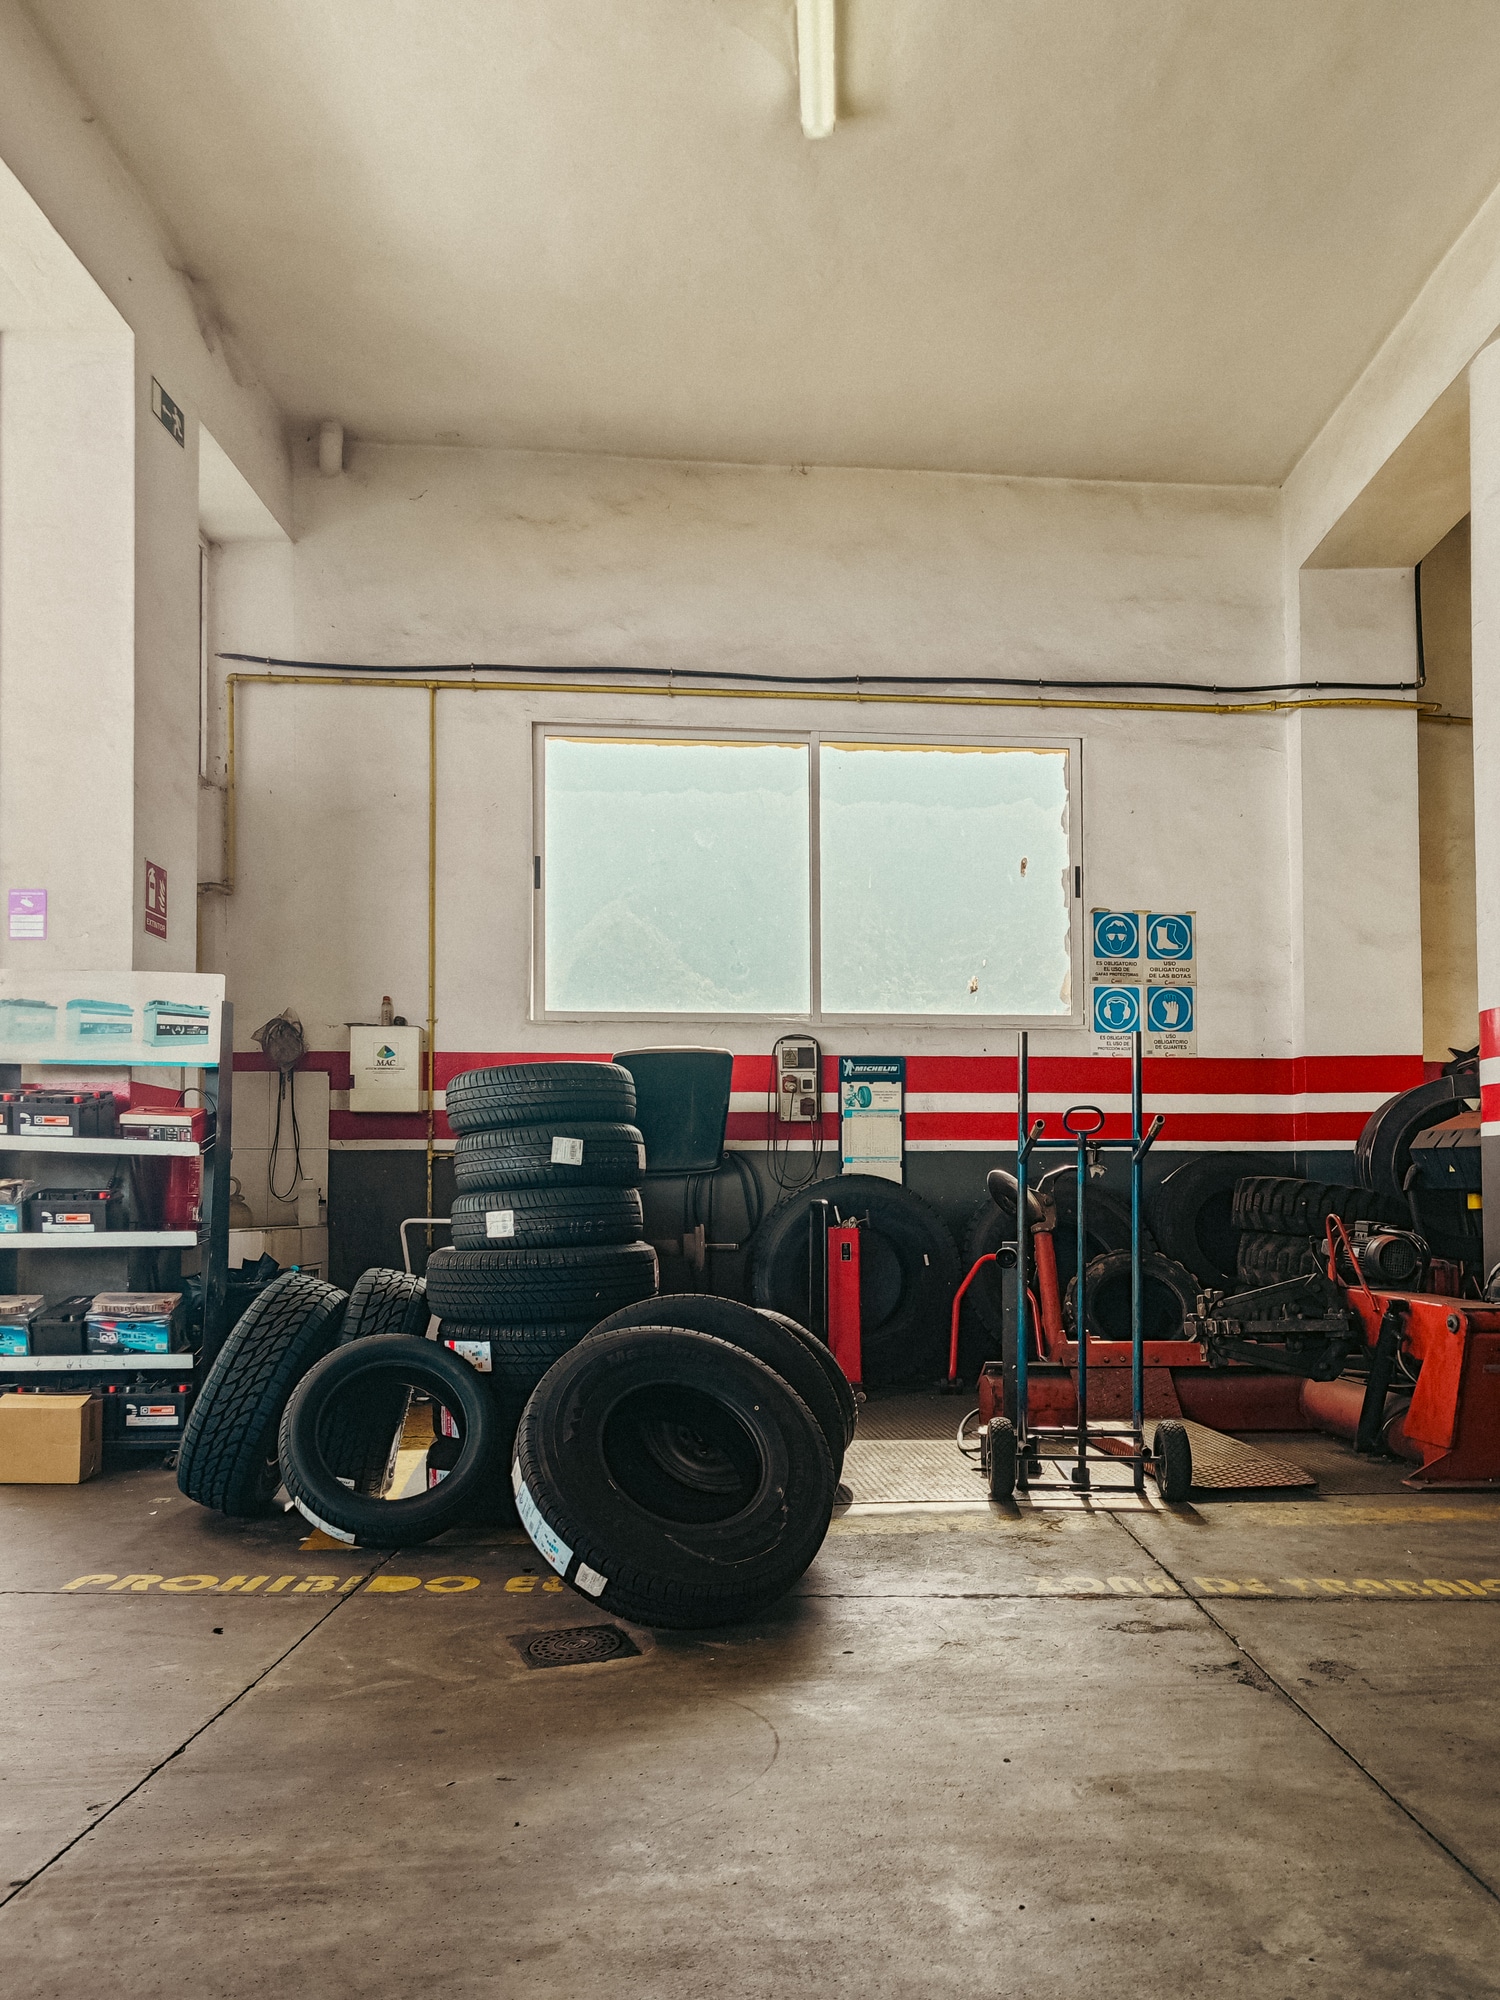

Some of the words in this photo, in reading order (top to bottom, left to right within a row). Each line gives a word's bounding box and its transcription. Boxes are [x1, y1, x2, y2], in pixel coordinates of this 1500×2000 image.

[146, 917, 166, 931] EXTINTOR
[60, 1574, 480, 1593] PROHIBIDO
[1024, 1576, 1181, 1594] ZONA
[1192, 1576, 1275, 1595] DE
